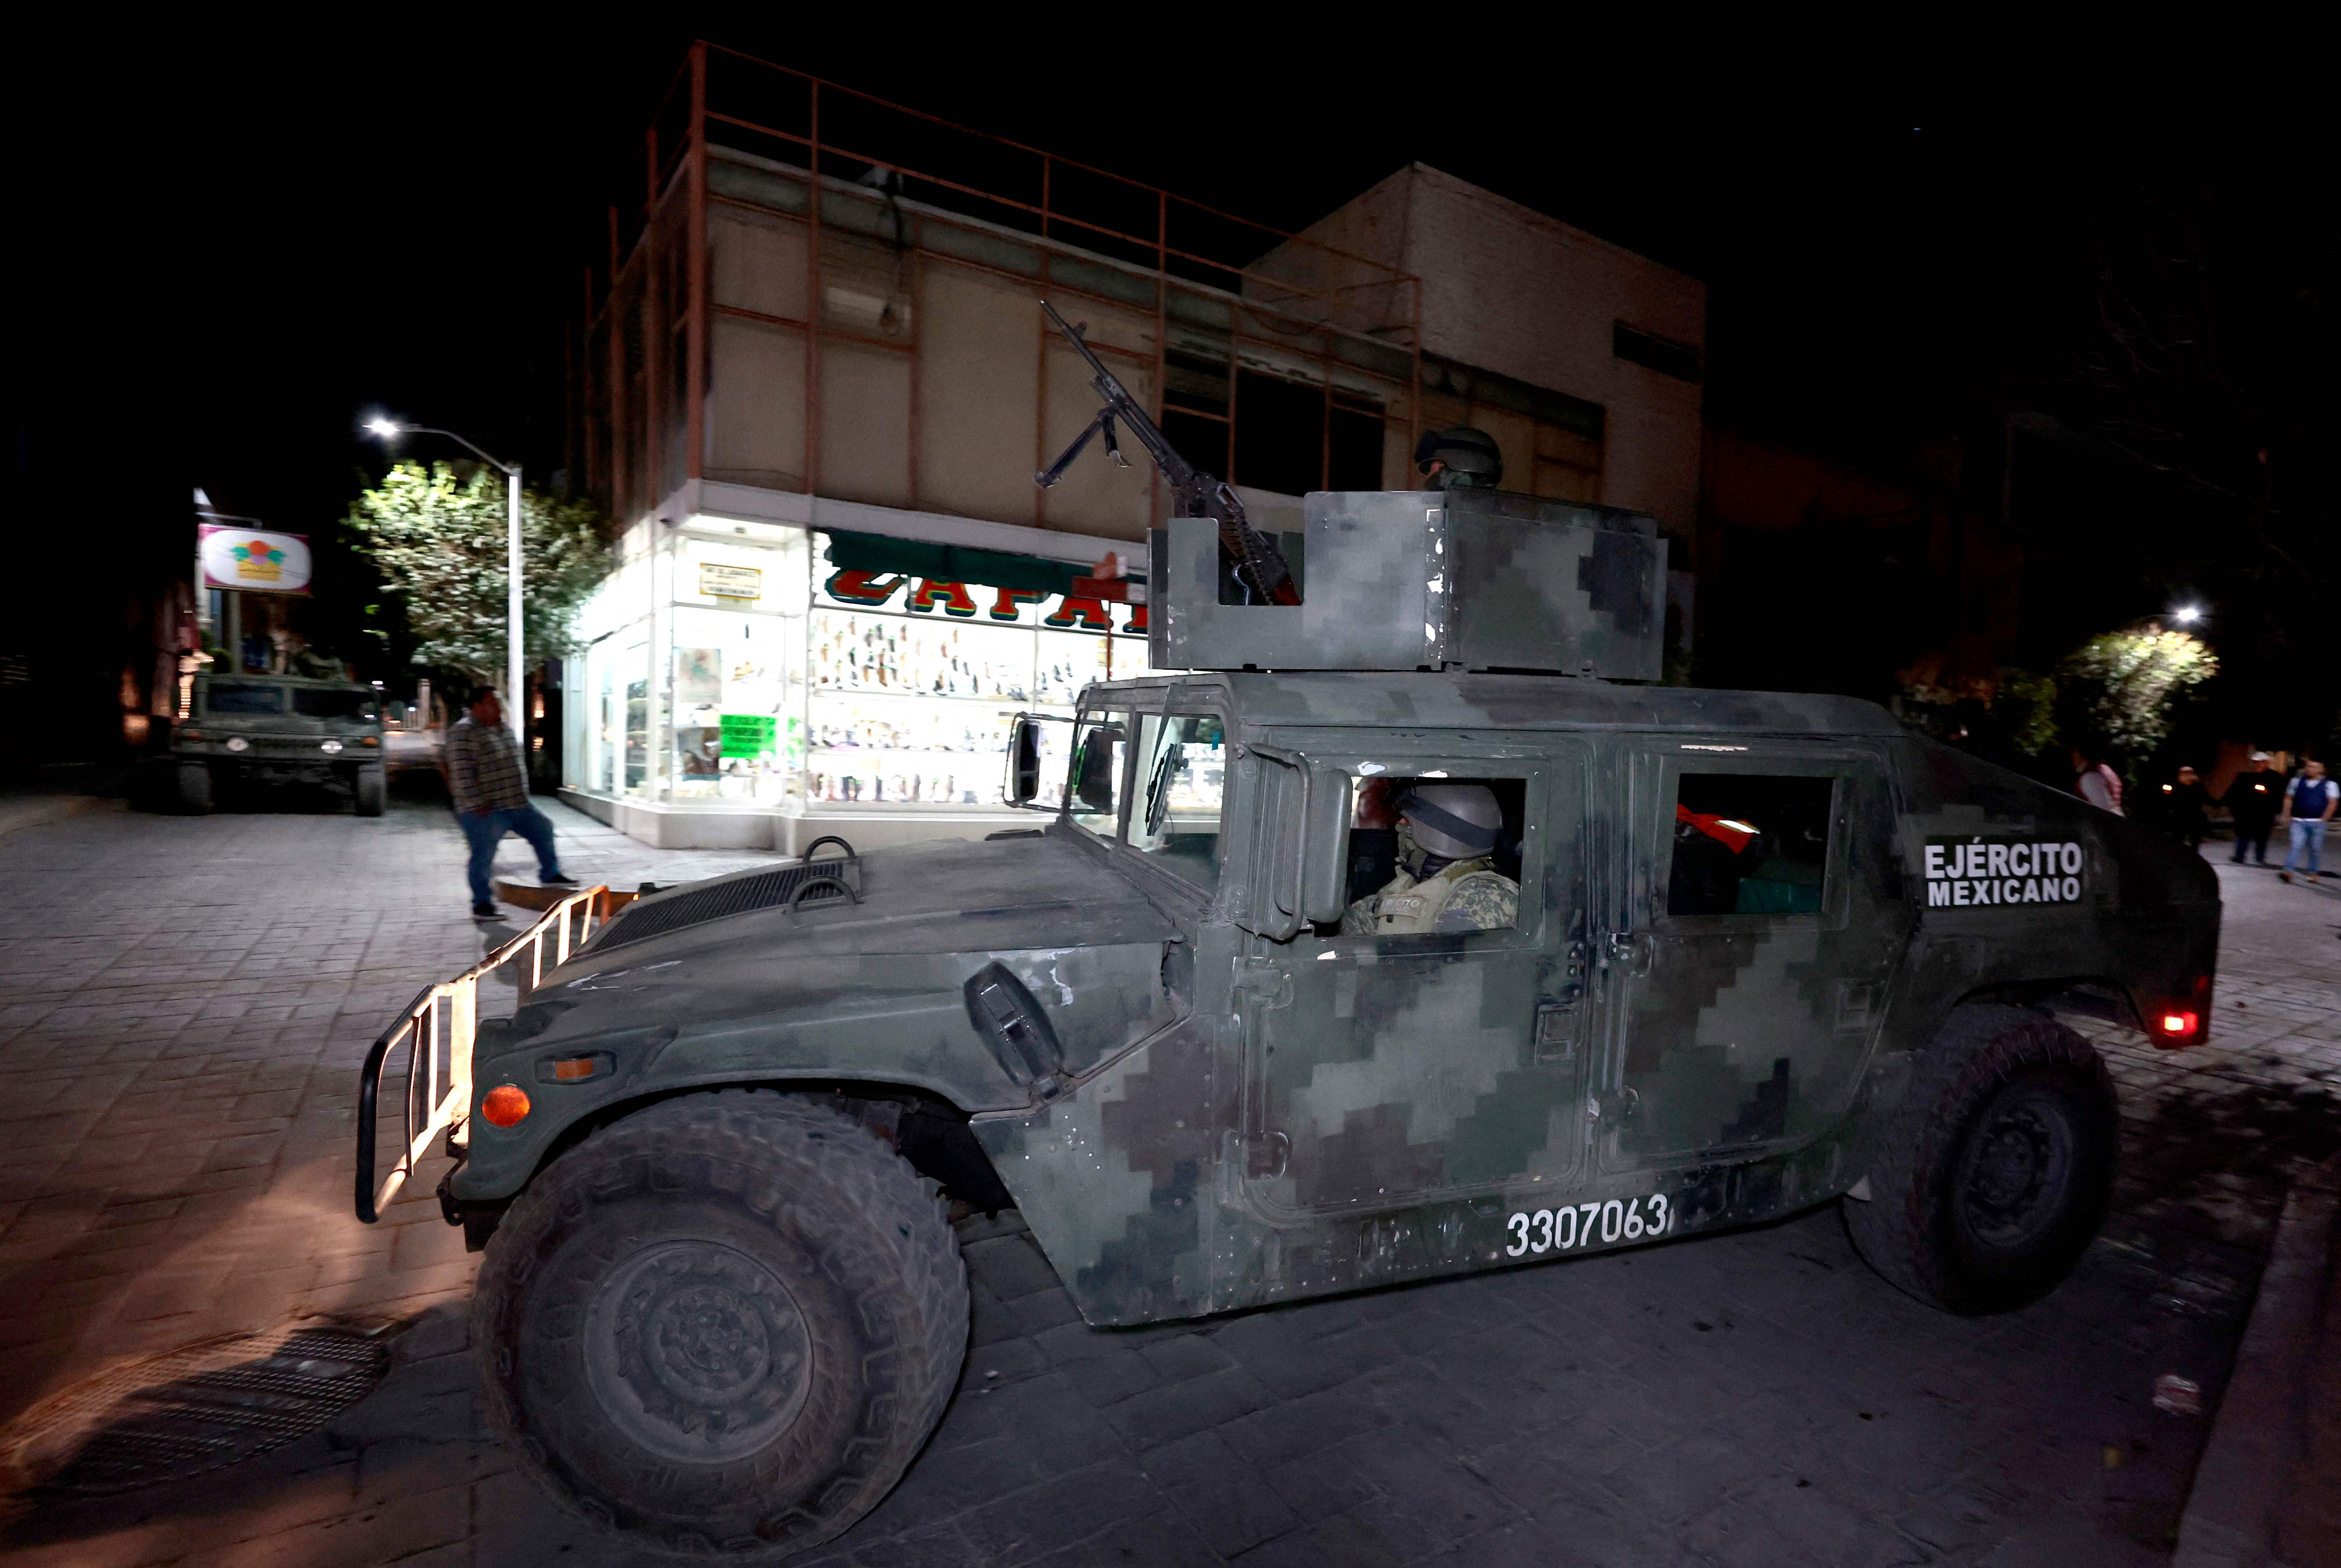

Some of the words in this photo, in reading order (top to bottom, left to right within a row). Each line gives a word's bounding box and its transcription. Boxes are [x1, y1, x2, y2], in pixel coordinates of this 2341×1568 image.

[825, 569, 1148, 634] ZAPA
[1925, 836, 2083, 879] EJÉRCITO
[1928, 877, 2081, 906] MEXICANO
[1507, 1193, 1667, 1257] 3307063
